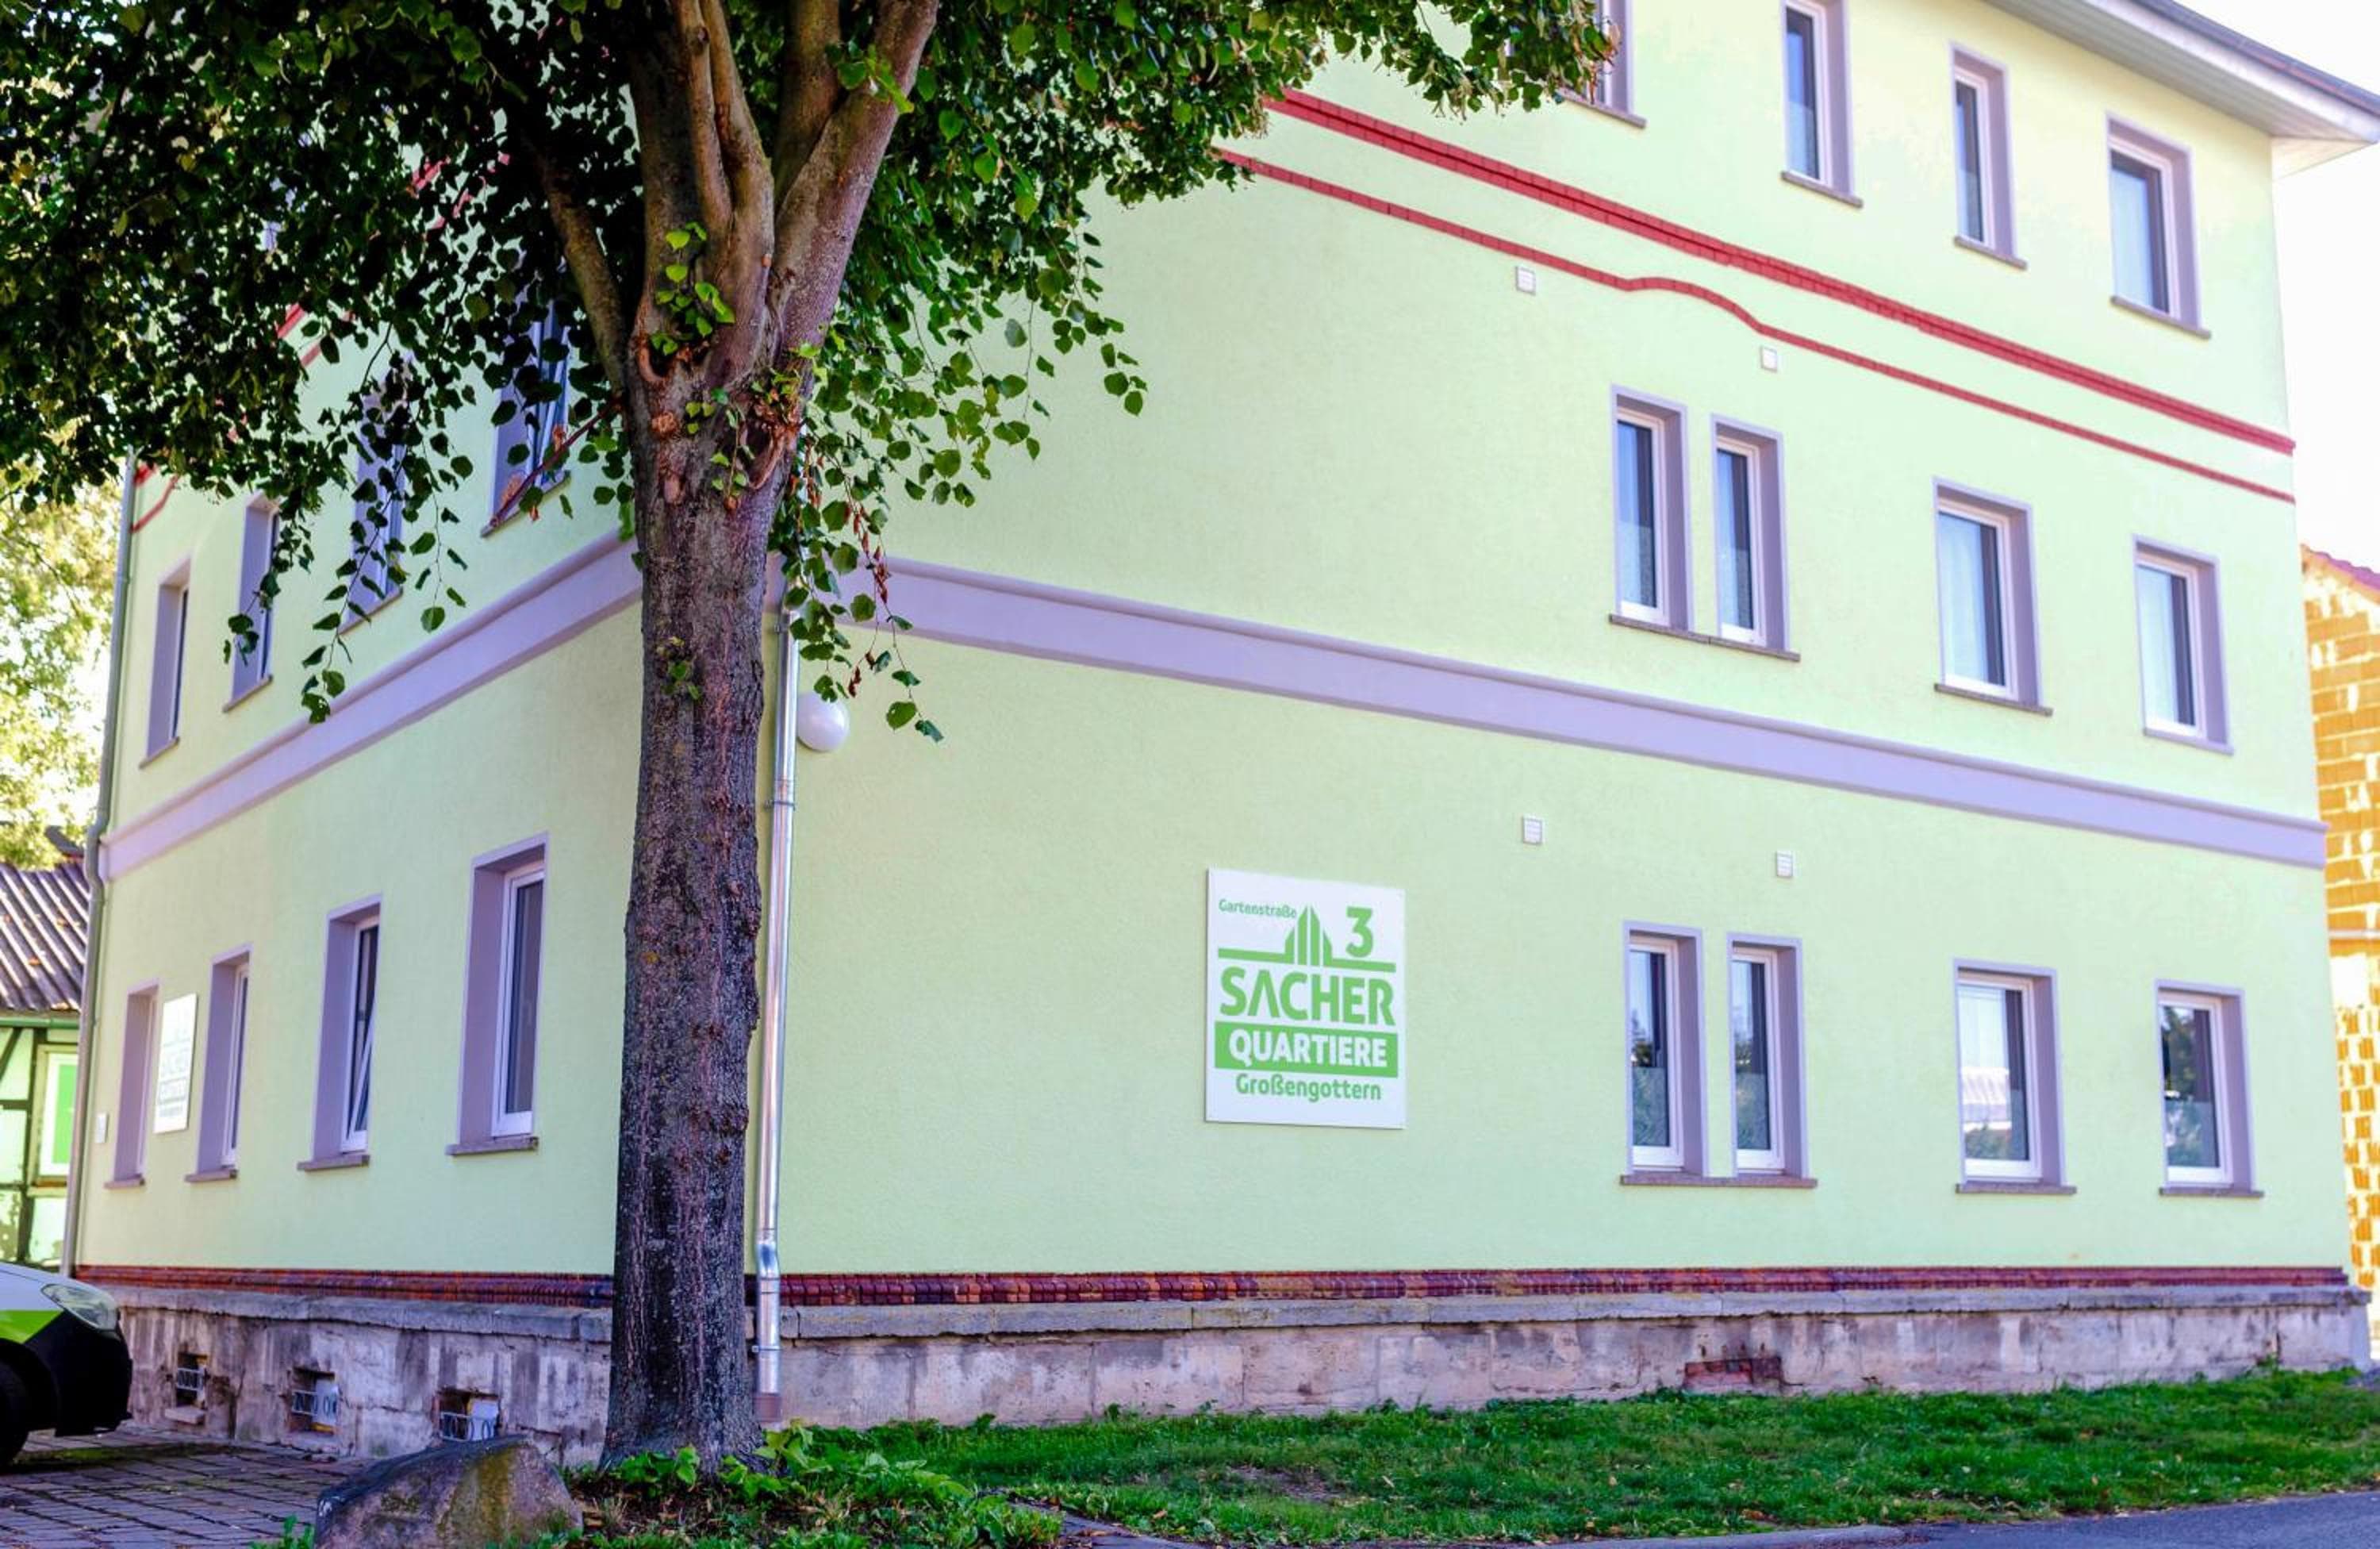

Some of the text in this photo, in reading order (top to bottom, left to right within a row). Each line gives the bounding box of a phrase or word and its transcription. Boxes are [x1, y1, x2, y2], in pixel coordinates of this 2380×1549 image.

[1218, 898, 1373, 958] Gartenstraße 3
[1220, 966, 1395, 1026] SACHER
[1229, 1029, 1388, 1067] QUARTIERE
[1236, 1073, 1381, 1102] Großengottern
